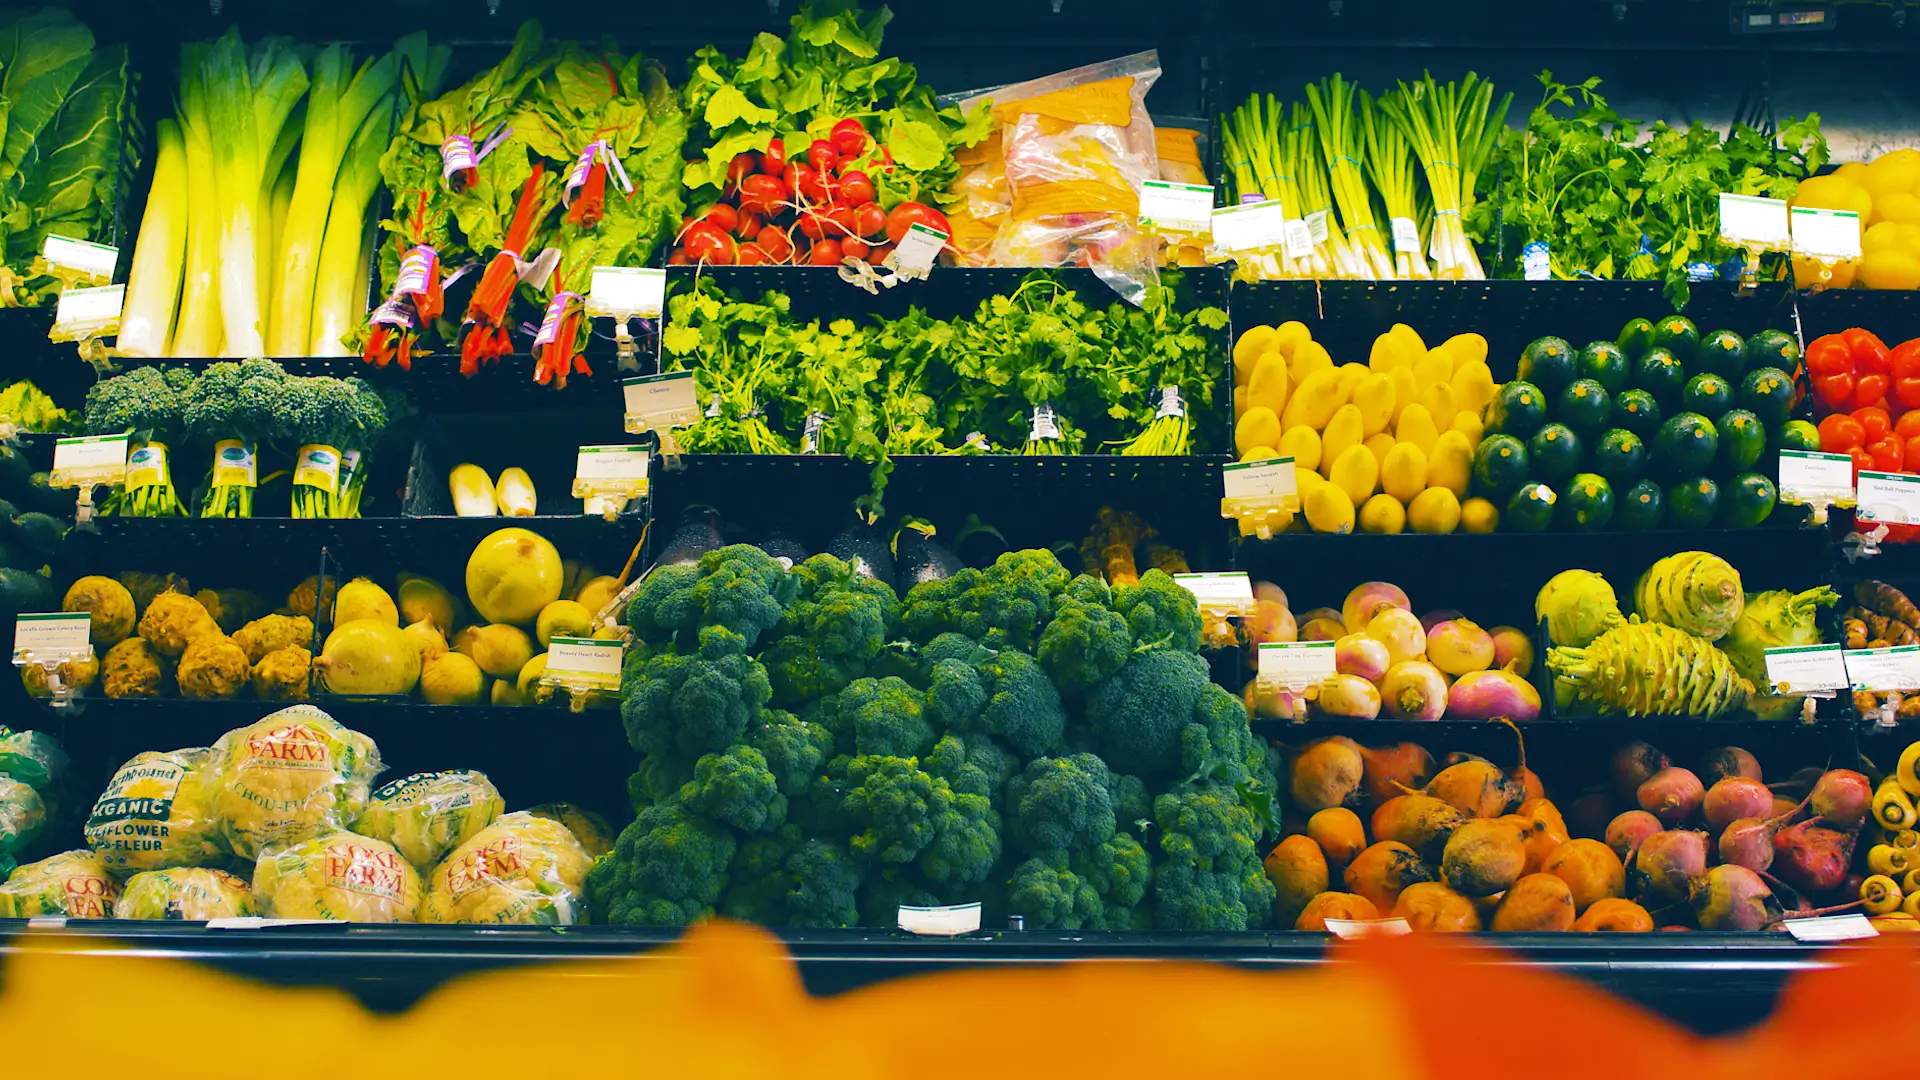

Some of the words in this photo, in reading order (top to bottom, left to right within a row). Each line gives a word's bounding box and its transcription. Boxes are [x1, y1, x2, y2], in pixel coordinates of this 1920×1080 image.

[249, 741, 326, 762] FARM
[106, 768, 177, 791] arthbound
[330, 857, 402, 893] FARM
[66, 877, 119, 896] COK
[73, 897, 114, 917] FAR
